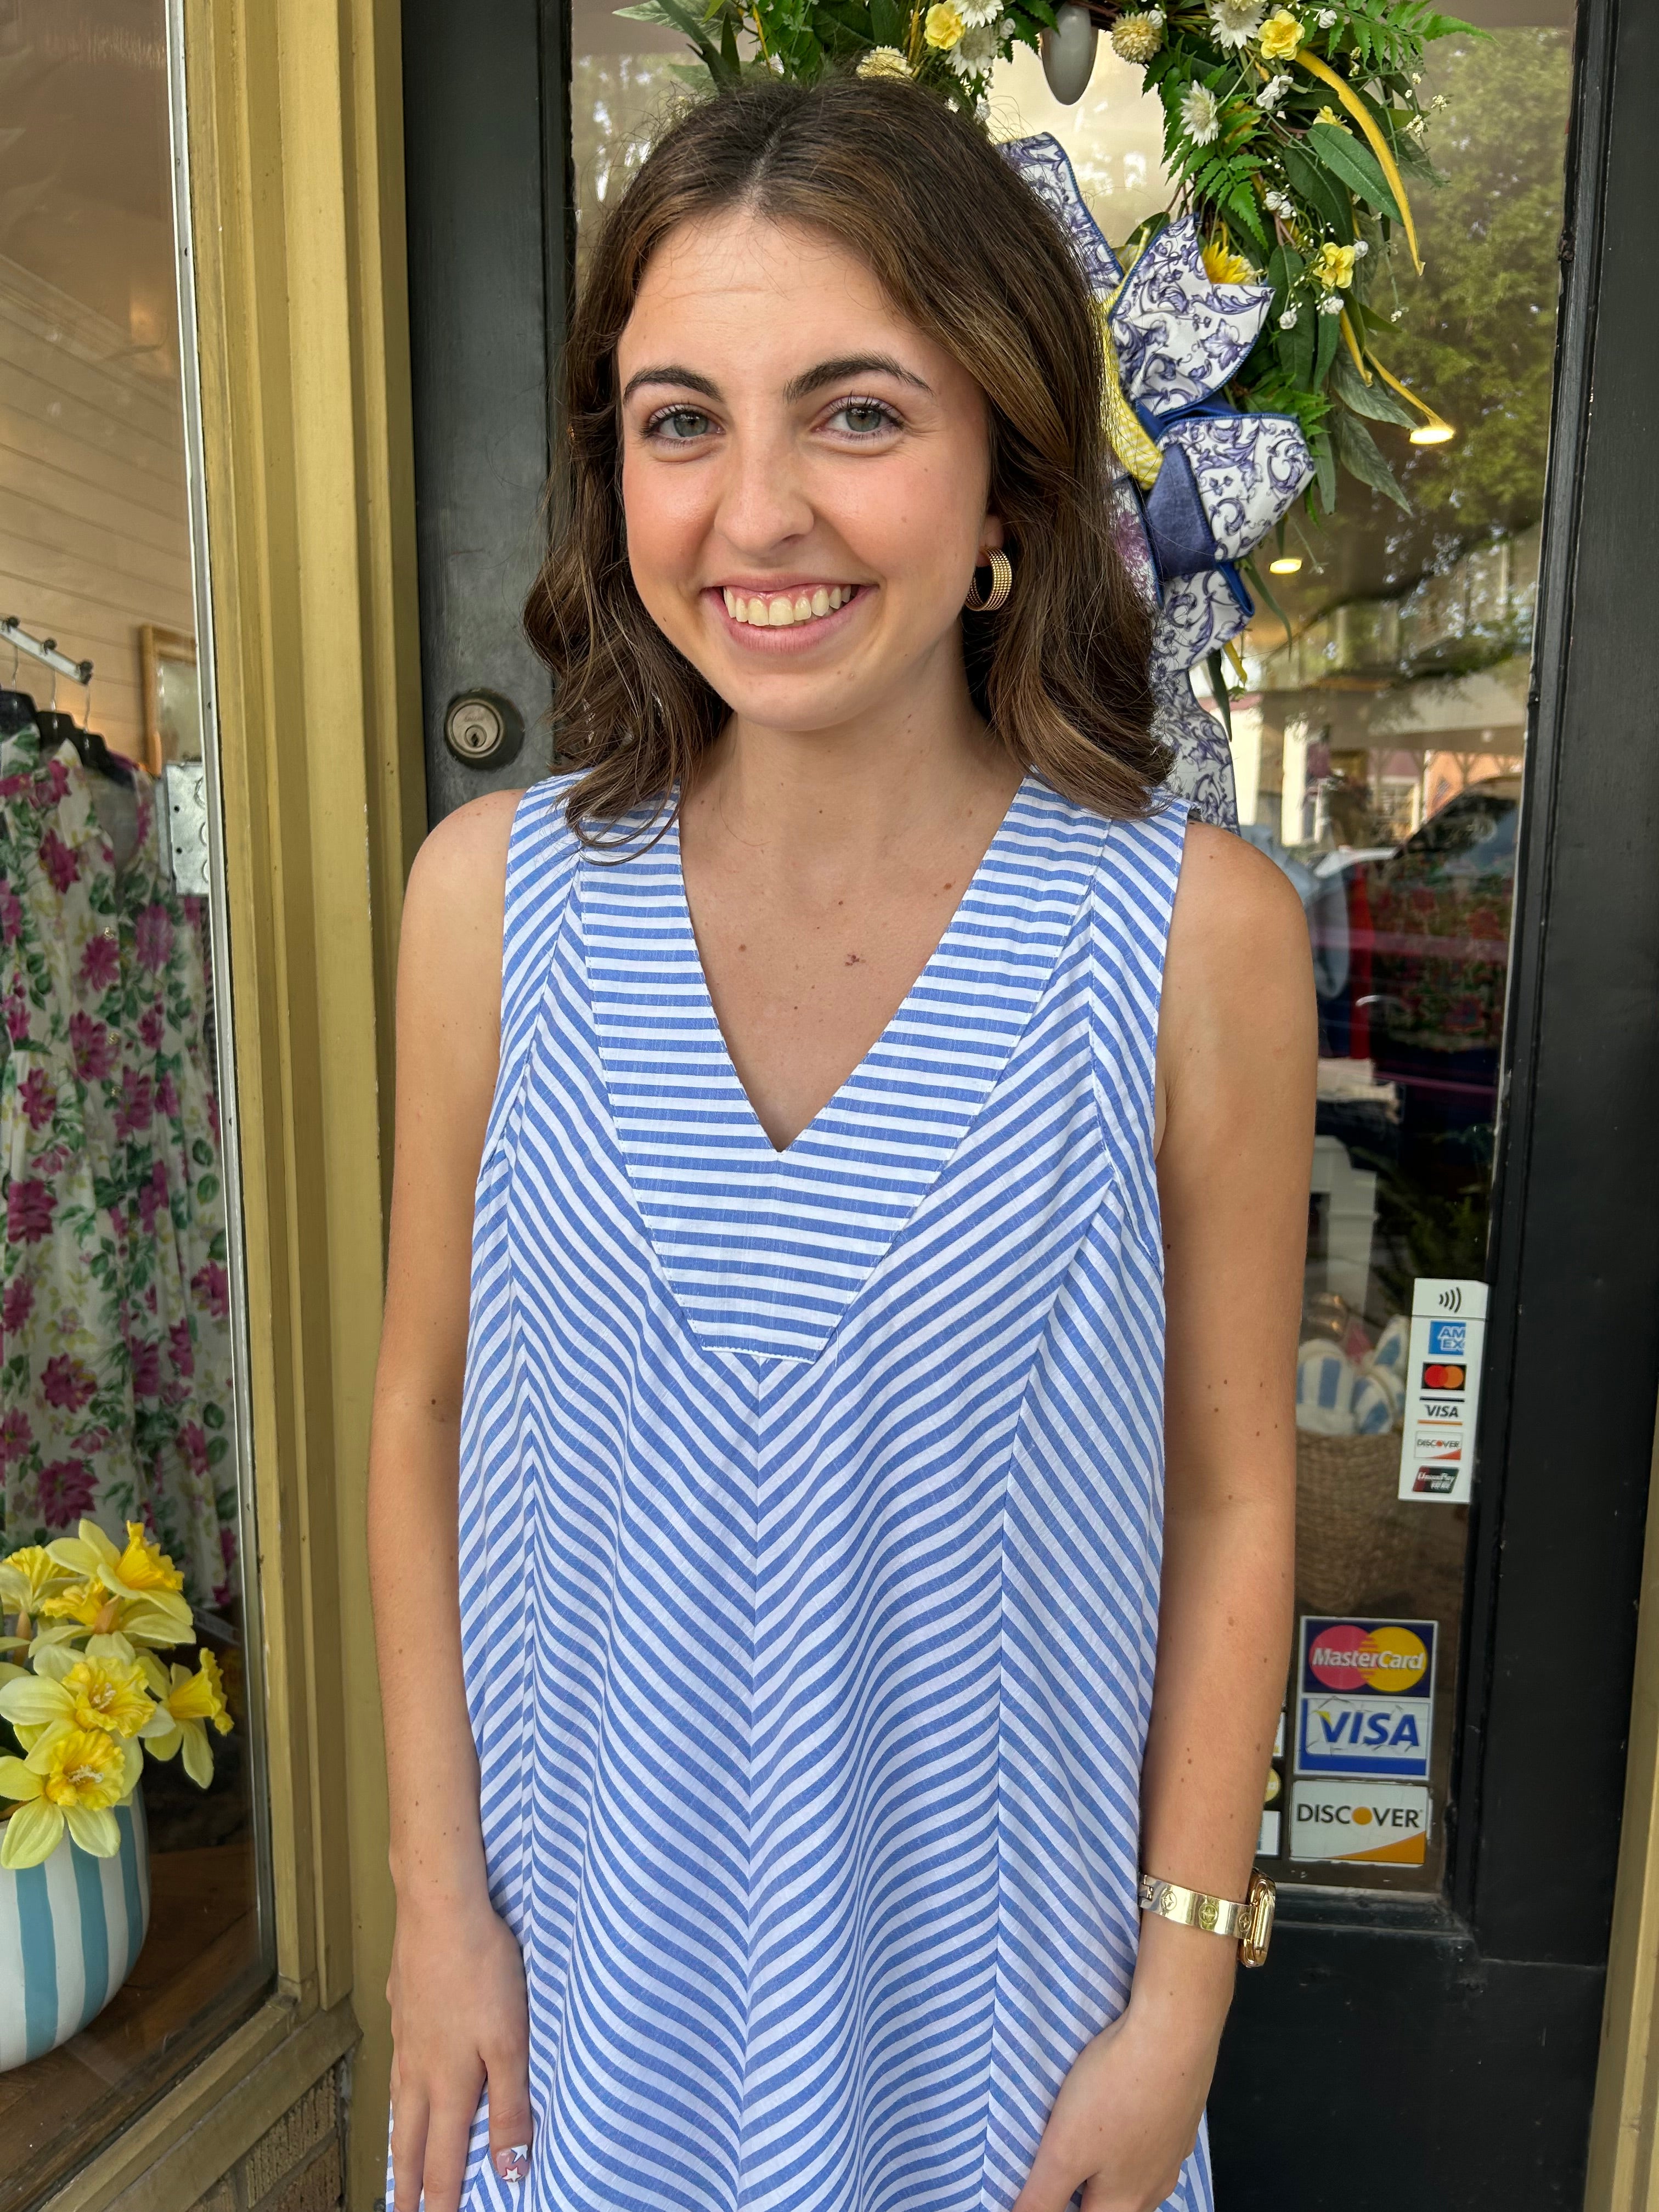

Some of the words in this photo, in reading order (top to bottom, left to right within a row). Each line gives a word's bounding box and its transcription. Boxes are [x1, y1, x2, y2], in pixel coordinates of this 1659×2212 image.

[1438, 1325, 1466, 1339] AM
[1425, 1404, 1459, 1418] VISA
[1417, 1438, 1460, 1448] DISCOVER
[1311, 1647, 1425, 1671] MasterCard
[1315, 1710, 1420, 1747] VISA
[1296, 1803, 1420, 1828] DISCOVER
